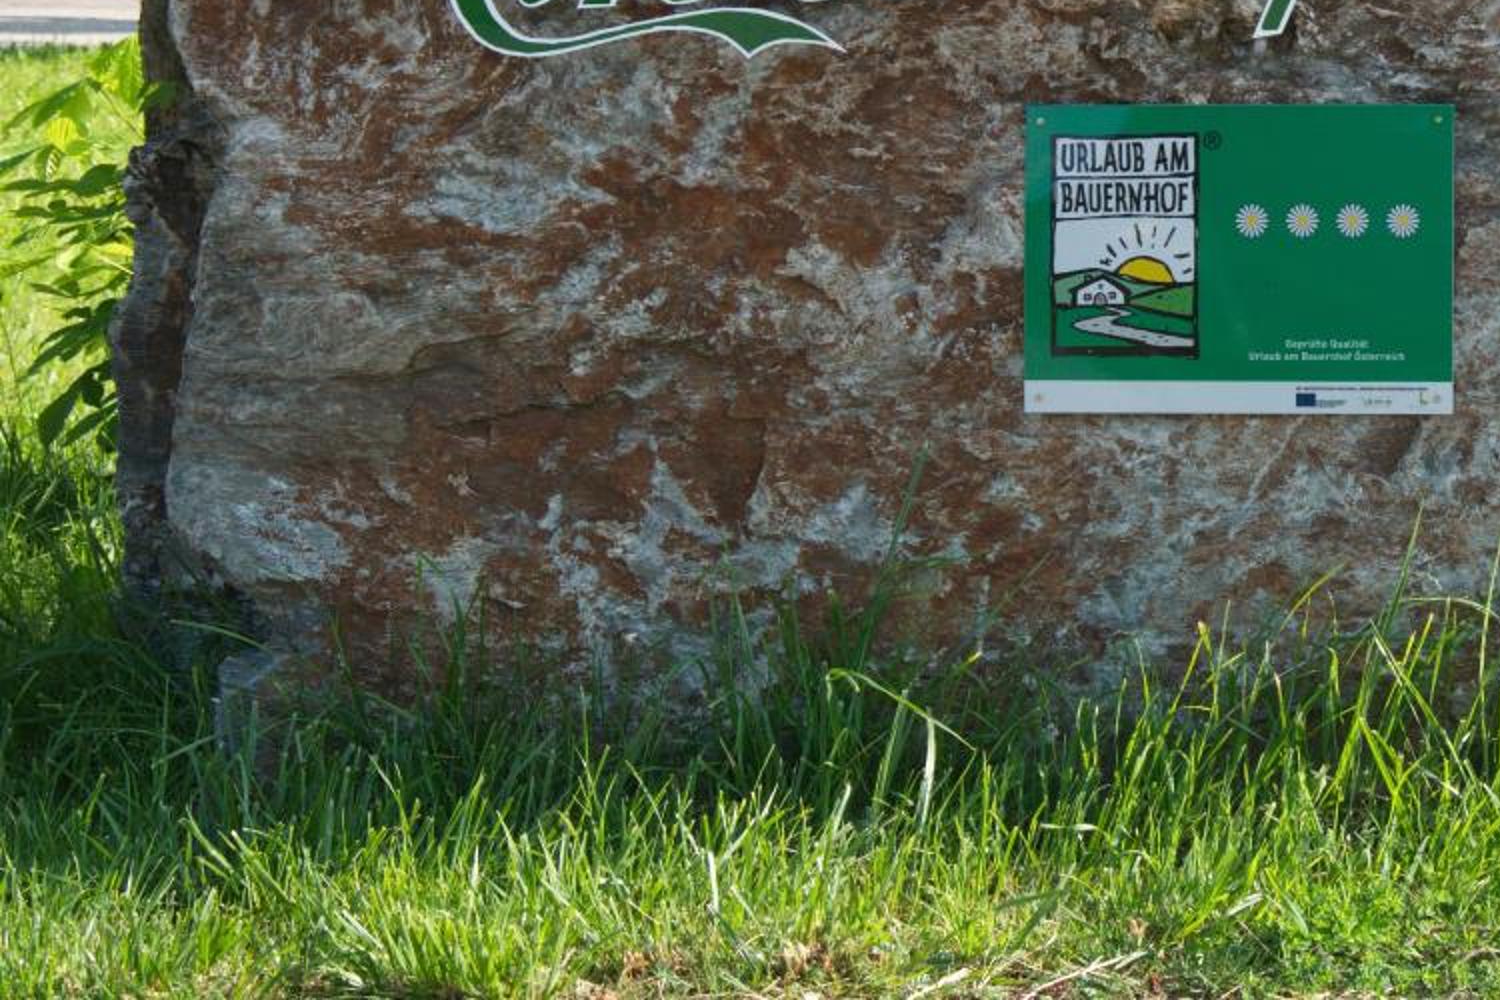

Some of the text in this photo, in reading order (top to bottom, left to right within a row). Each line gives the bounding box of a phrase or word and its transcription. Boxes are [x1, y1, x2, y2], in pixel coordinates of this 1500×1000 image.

[1061, 141, 1189, 172] URLAUB AM
[1061, 182, 1189, 213] BAUERNHOF
[1248, 351, 1282, 361] Urlaub
[1284, 353, 1299, 361] am
[1301, 351, 1352, 361] Bauernhof
